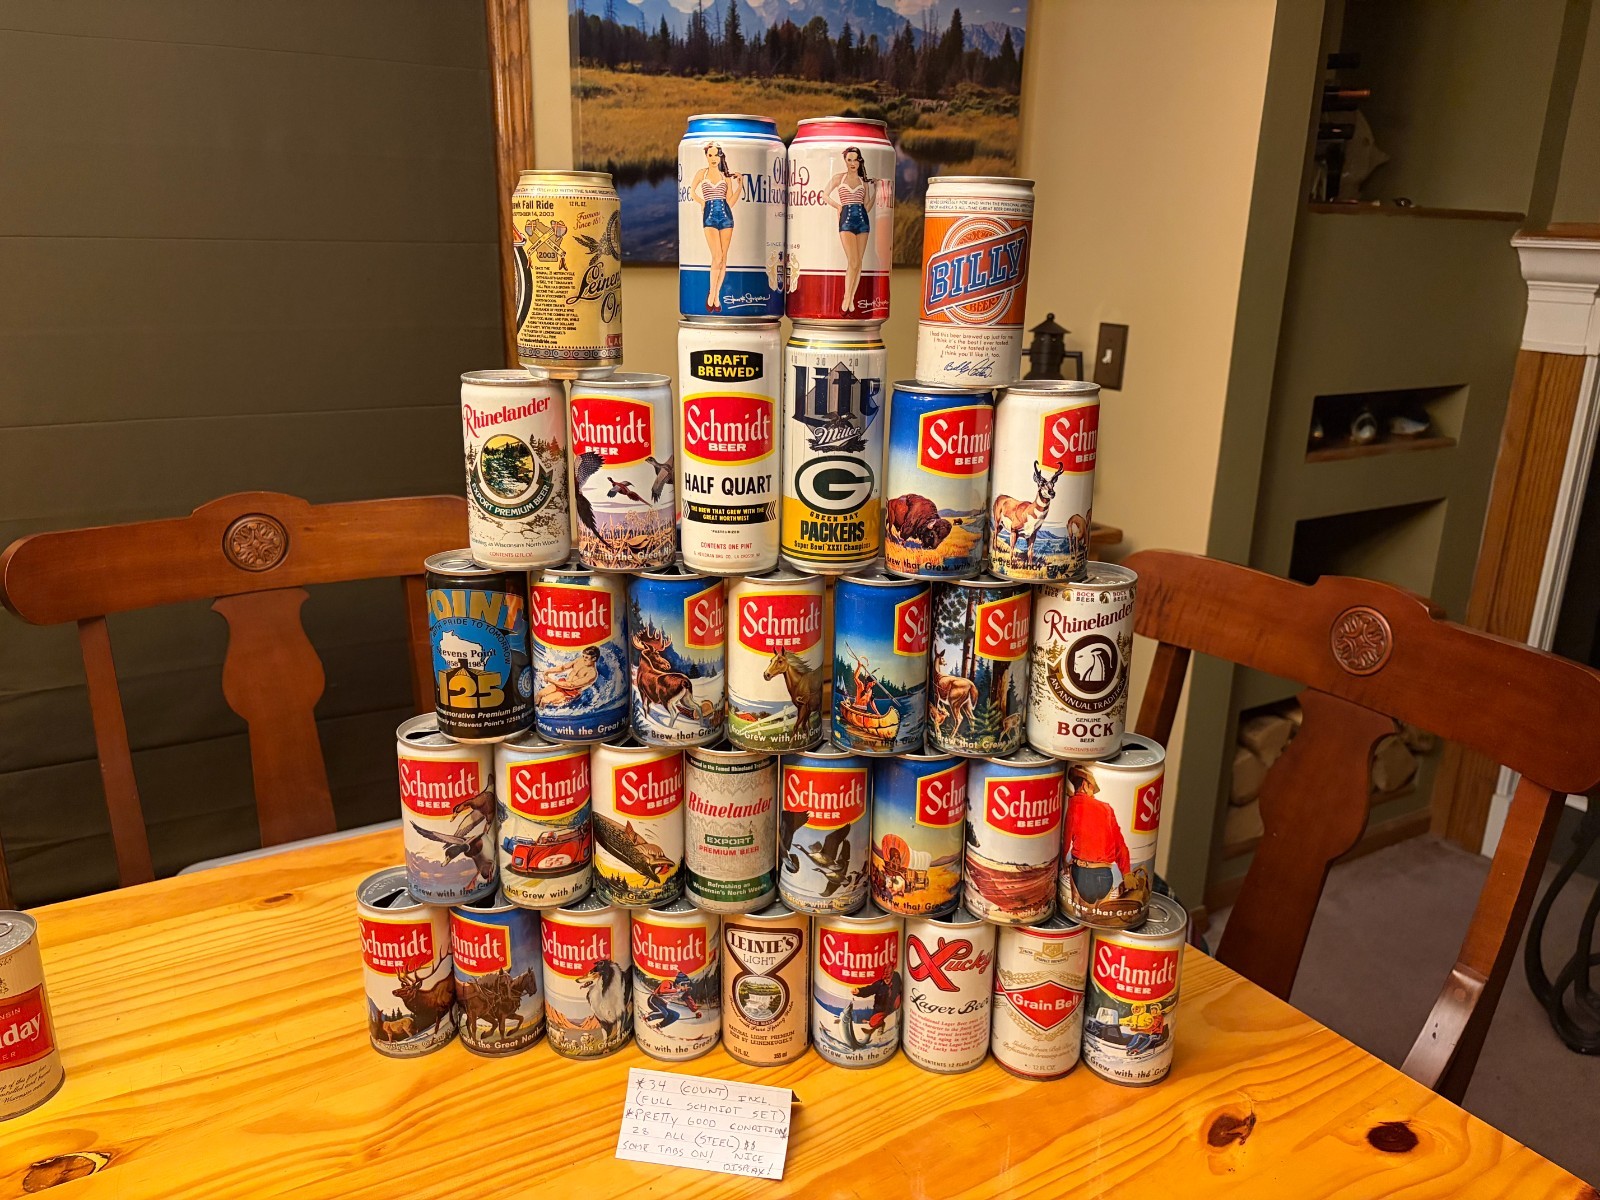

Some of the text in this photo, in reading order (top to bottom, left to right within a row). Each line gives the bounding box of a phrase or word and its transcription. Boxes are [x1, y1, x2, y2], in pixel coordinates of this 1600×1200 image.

[522, 200, 554, 210] Fall Ride
[930, 238, 1024, 305] BILLY
[969, 298, 999, 313] BEER
[704, 354, 748, 366] DRAFT
[698, 366, 754, 378] BREWED
[792, 364, 880, 425] Lite
[463, 397, 550, 439] Rhinelander
[571, 406, 646, 444] Schmidt
[686, 404, 771, 445] Schmidt
[814, 426, 861, 445] Miller
[585, 446, 618, 456] BEER
[708, 444, 746, 452] BEER
[954, 456, 984, 466] BEER
[684, 474, 772, 496] HALF QUART
[472, 482, 550, 516] EXPORT PREMIUM BEER
[810, 512, 858, 522] GREEN BAY
[800, 520, 864, 542] PACKERS
[700, 542, 726, 550] CONTENTS
[794, 540, 870, 552] Super Bowl Champions
[904, 560, 950, 572] that Grew
[428, 590, 524, 630] OINT
[532, 592, 608, 629] Schmidt
[742, 600, 820, 638] Schmidt
[1044, 601, 1134, 642] Rhinelander
[444, 618, 511, 665] PRIDE TO TOMORROW
[546, 630, 581, 639] BEER
[766, 638, 802, 646] BEER
[470, 649, 496, 658] Point
[438, 670, 505, 708] 125
[1050, 676, 1126, 710] AN ANNUAL TRADITION
[478, 704, 526, 718] Premium Beer
[556, 722, 620, 736] with the Great
[652, 729, 694, 740] Brew that
[1056, 721, 1114, 738] BOCK
[744, 731, 790, 743] Grew with
[959, 738, 978, 749] that
[400, 763, 476, 800] Schmidt
[514, 761, 590, 804] Schmidt
[787, 773, 862, 810] Schmidt
[416, 800, 450, 809] BEER
[540, 796, 574, 810] BEER
[646, 794, 676, 810] BEER
[688, 791, 772, 818] Rhinelander
[808, 811, 840, 819] BEER
[1016, 818, 1050, 828] BEER
[706, 836, 752, 845] EXPORT
[699, 844, 760, 856] PREMIUM BEER
[414, 885, 456, 898] Grew with
[522, 883, 582, 900] Grew with the
[692, 881, 746, 896] Wisconsin's North
[708, 880, 742, 890] Refreshing
[627, 890, 650, 901] Grew
[903, 900, 921, 911] that
[1068, 898, 1088, 912] Brew
[1092, 908, 1110, 916] that
[1116, 908, 1138, 917] Grew
[360, 922, 428, 958] Schmidt
[541, 921, 607, 962] Schmidt
[633, 924, 703, 963] Schmidt
[730, 931, 794, 954] LEINIE'S
[822, 934, 897, 970] Schmidt
[372, 958, 404, 967] BEER
[552, 958, 582, 970] BEER
[647, 960, 679, 971] BEER
[743, 954, 776, 966] LIGHT
[907, 934, 994, 992] Lucky
[1096, 946, 1176, 986] Schmidt
[842, 969, 875, 978] BEER
[1116, 982, 1152, 994] BEER
[910, 988, 990, 1015] Lager Beer
[1012, 994, 1052, 1011] Grain
[770, 1030, 795, 1040] PREMIUM
[478, 1039, 518, 1050] the Great
[579, 1038, 620, 1052] the Great
[654, 1037, 713, 1054] with the Great
[822, 1045, 880, 1061] Grew with the
[920, 1057, 946, 1068] CONTENTS
[1090, 1057, 1151, 1078] Grew with the
[680, 1080, 729, 1100] (COUNT)
[738, 1095, 771, 1106] INCL.
[636, 1090, 786, 1123] (FULL SCHMIDT SET)
[634, 1108, 678, 1128] PRETTY
[688, 1118, 716, 1128] GOOD
[632, 1126, 756, 1154] 28 ALL (STEEL) $$
[622, 1140, 764, 1164] SOME TABS ON! NICE
[724, 1163, 774, 1176] DISPLAY!
